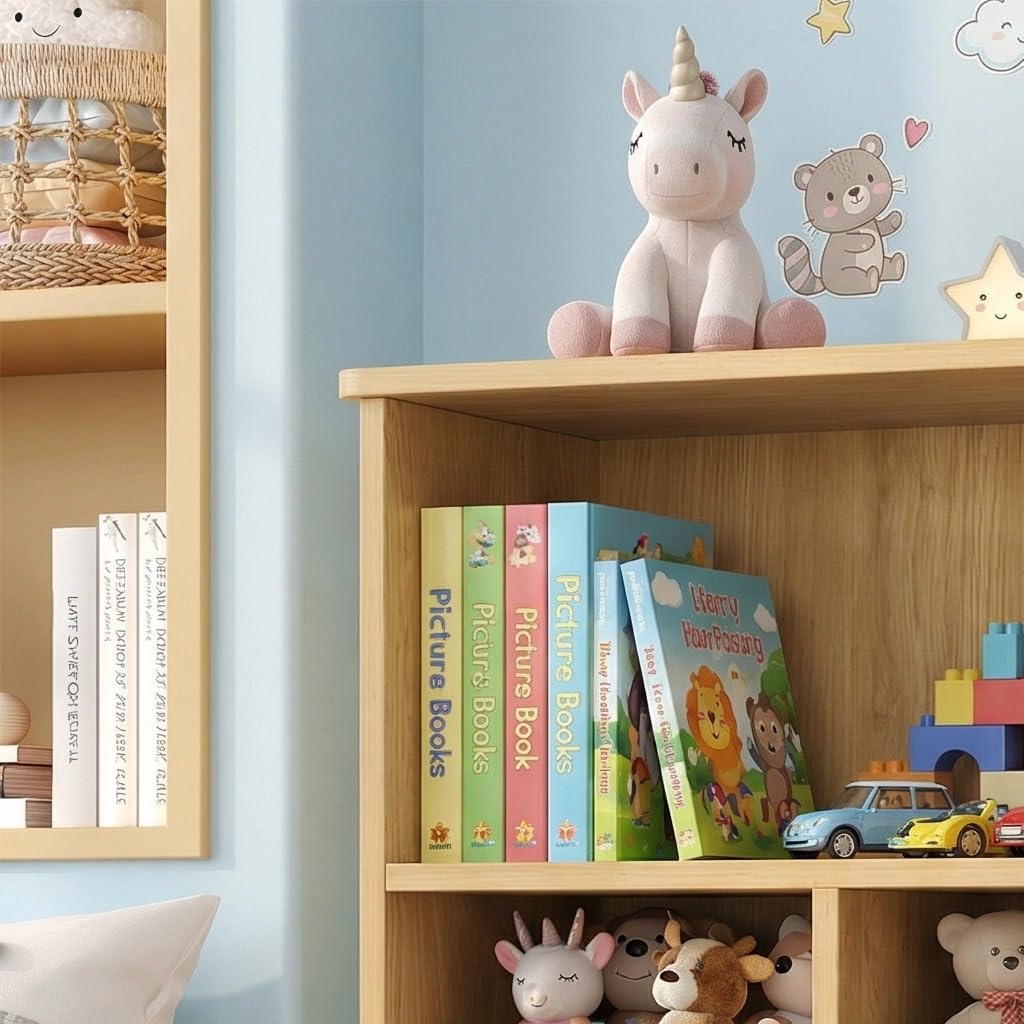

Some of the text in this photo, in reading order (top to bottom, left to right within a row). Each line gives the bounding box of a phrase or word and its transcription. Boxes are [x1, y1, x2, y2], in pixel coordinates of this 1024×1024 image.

[429, 588, 452, 778] Picture Books
[472, 697, 496, 775] Books
[515, 607, 539, 770] Picture Book
[556, 575, 581, 775] Picture Books
